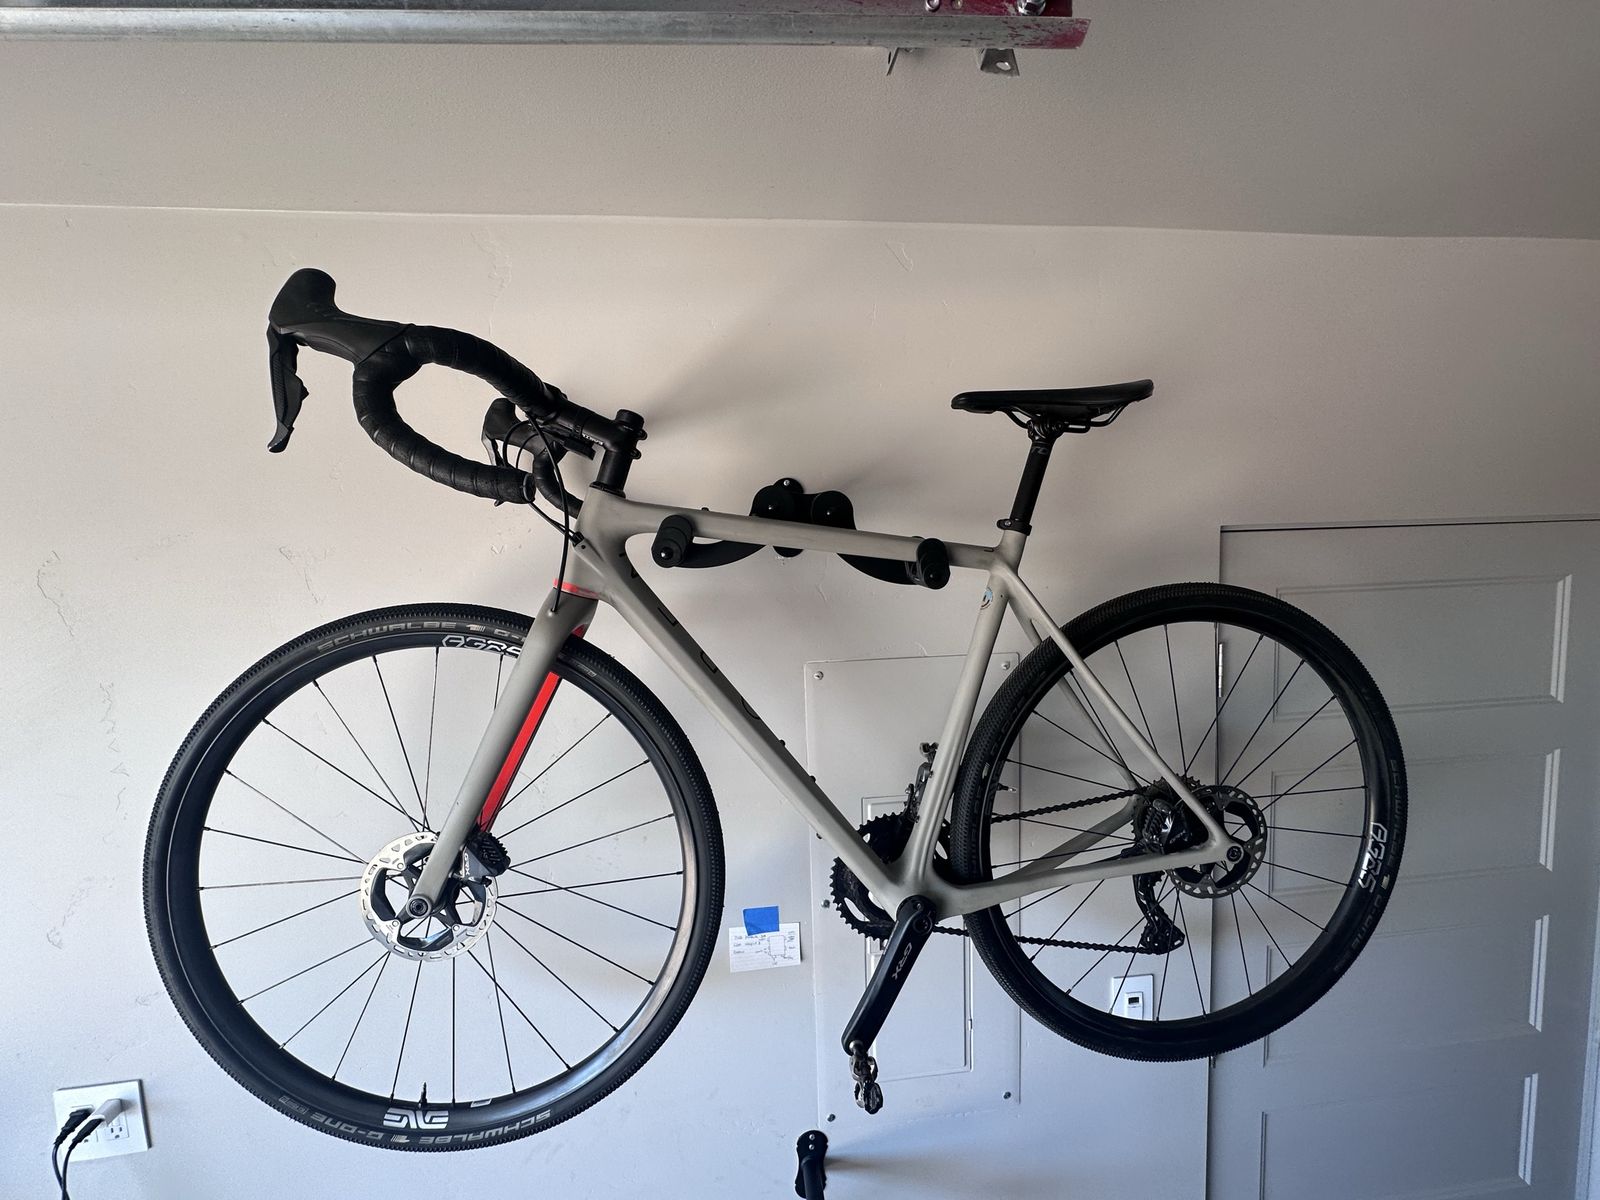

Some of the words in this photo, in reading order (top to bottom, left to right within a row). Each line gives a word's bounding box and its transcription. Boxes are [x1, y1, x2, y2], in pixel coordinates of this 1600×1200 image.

[317, 621, 456, 651] SCHWALBE
[891, 942, 913, 980] GRX
[309, 1112, 383, 1140] G-ONE
[418, 1109, 551, 1145] SCHWALBE
